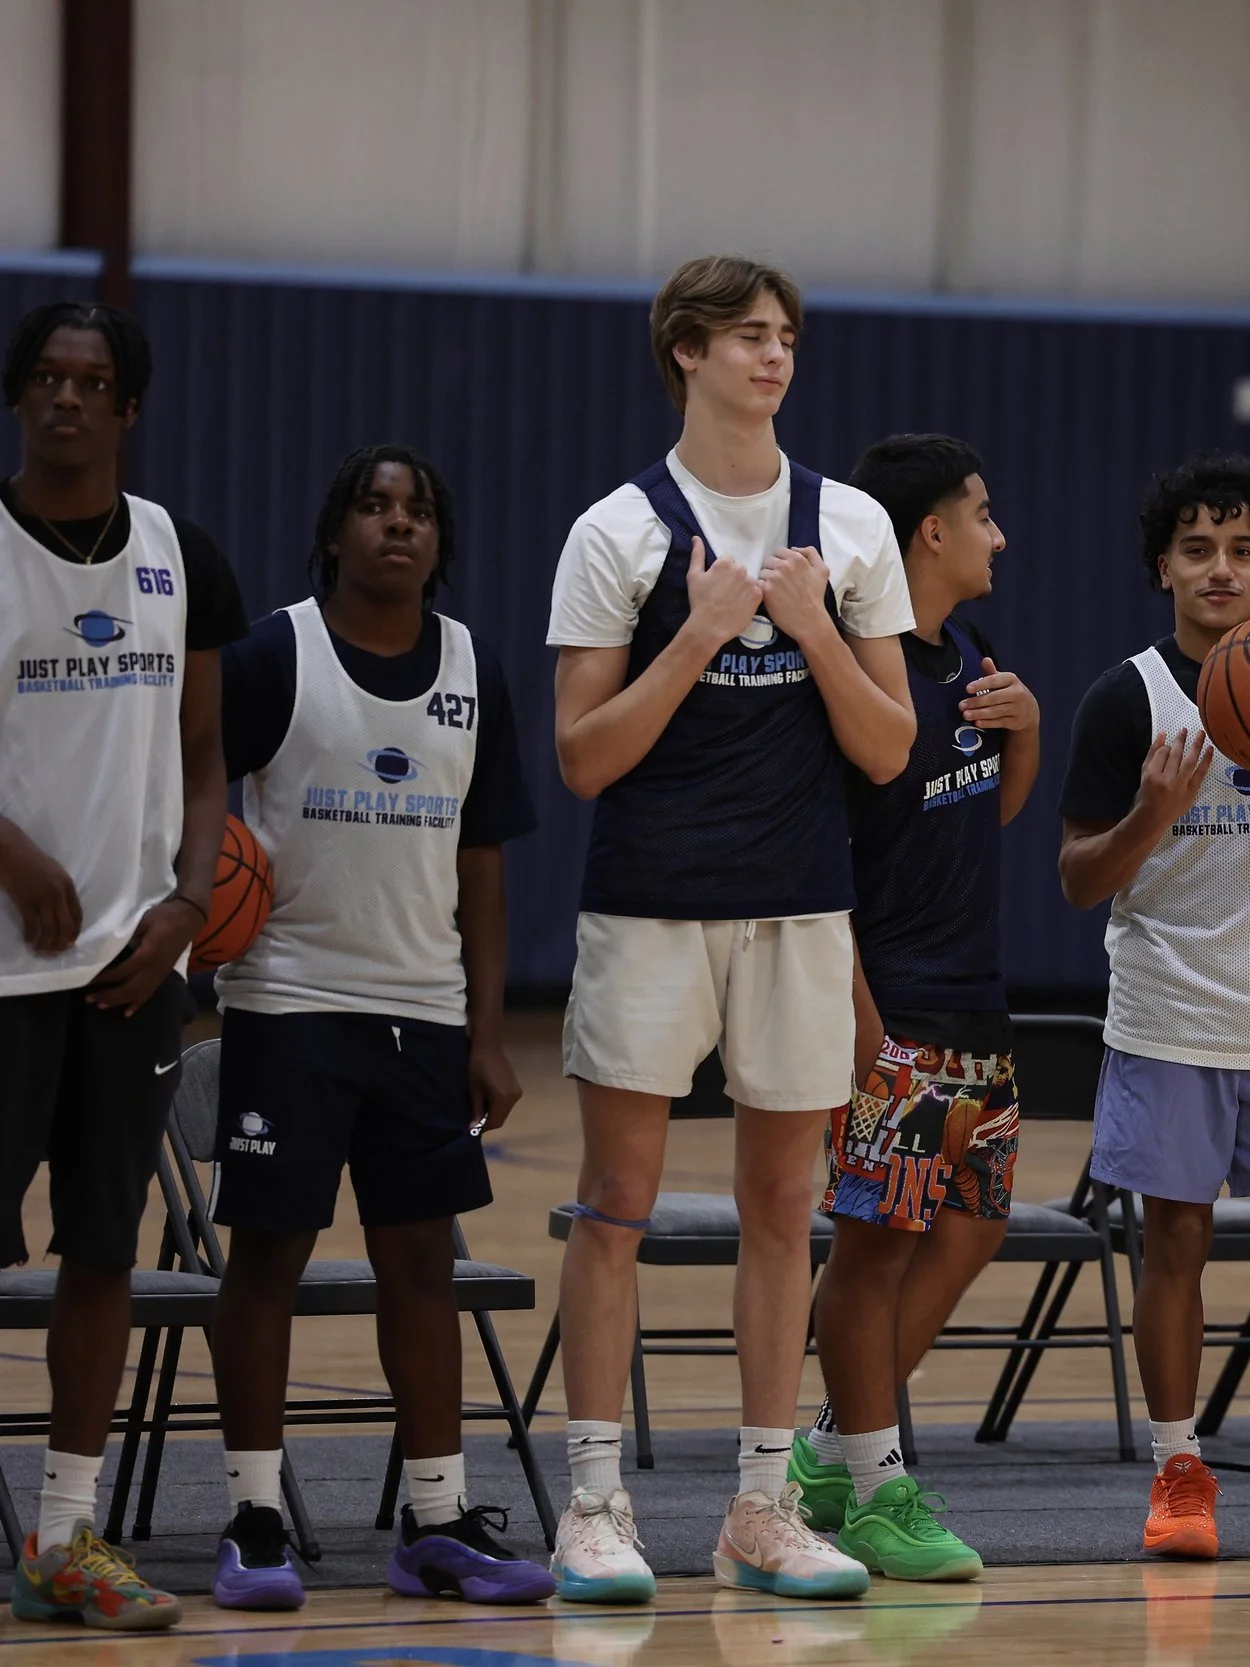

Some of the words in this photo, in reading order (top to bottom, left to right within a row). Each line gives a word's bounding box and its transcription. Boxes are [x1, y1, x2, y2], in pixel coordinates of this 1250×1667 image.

[136, 567, 174, 596] 616
[17, 659, 59, 680] JUST
[66, 656, 110, 677] PLAY
[118, 652, 175, 673] SPORTS
[720, 653, 762, 674] PLAY
[764, 650, 805, 673] SPOR
[17, 677, 85, 694] BASKETBALL
[89, 673, 138, 690] TRAINING
[738, 671, 784, 687] TRAINING
[426, 692, 477, 731] 427
[923, 773, 951, 801] JUST
[302, 786, 348, 808] JUST
[354, 790, 399, 812] PLAY
[405, 793, 459, 816] SPORTS
[302, 807, 371, 825] BASKETBALL
[376, 812, 422, 828] TRAINING
[424, 815, 456, 829] FACILITY
[1172, 823, 1233, 837] BASKETBALL
[229, 1136, 250, 1153] JUST
[250, 1139, 277, 1155] PLAY
